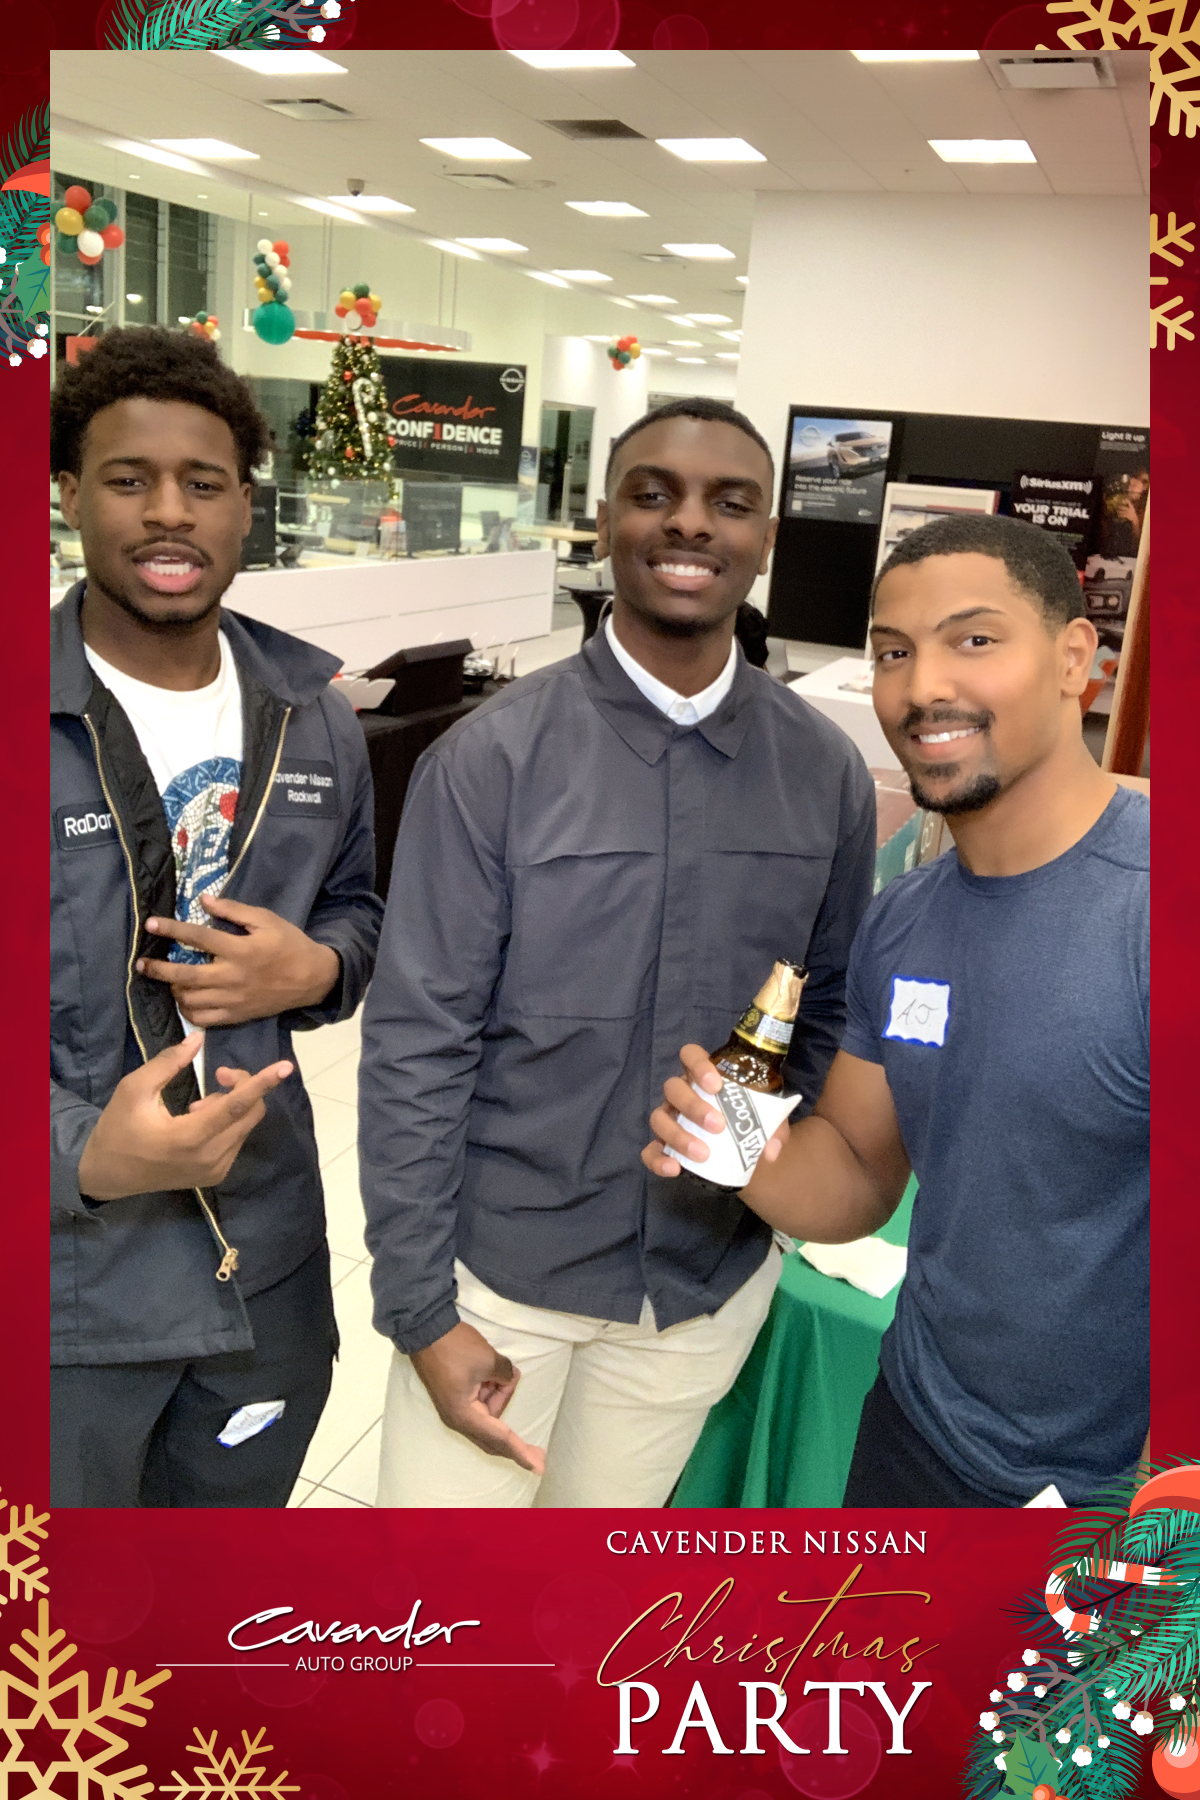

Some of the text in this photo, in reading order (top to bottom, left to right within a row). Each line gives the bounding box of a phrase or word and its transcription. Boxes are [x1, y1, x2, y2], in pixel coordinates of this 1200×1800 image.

[391, 393, 496, 420] Cavender
[1101, 431, 1124, 441] Light
[430, 442, 464, 453] PERSON
[476, 446, 500, 455] HOUR
[1014, 503, 1090, 519] YOUR TRIAL
[1032, 514, 1069, 527] IS ON
[274, 772, 308, 785] avender
[287, 789, 322, 804] Rockwall
[721, 1077, 755, 1136] Cocin
